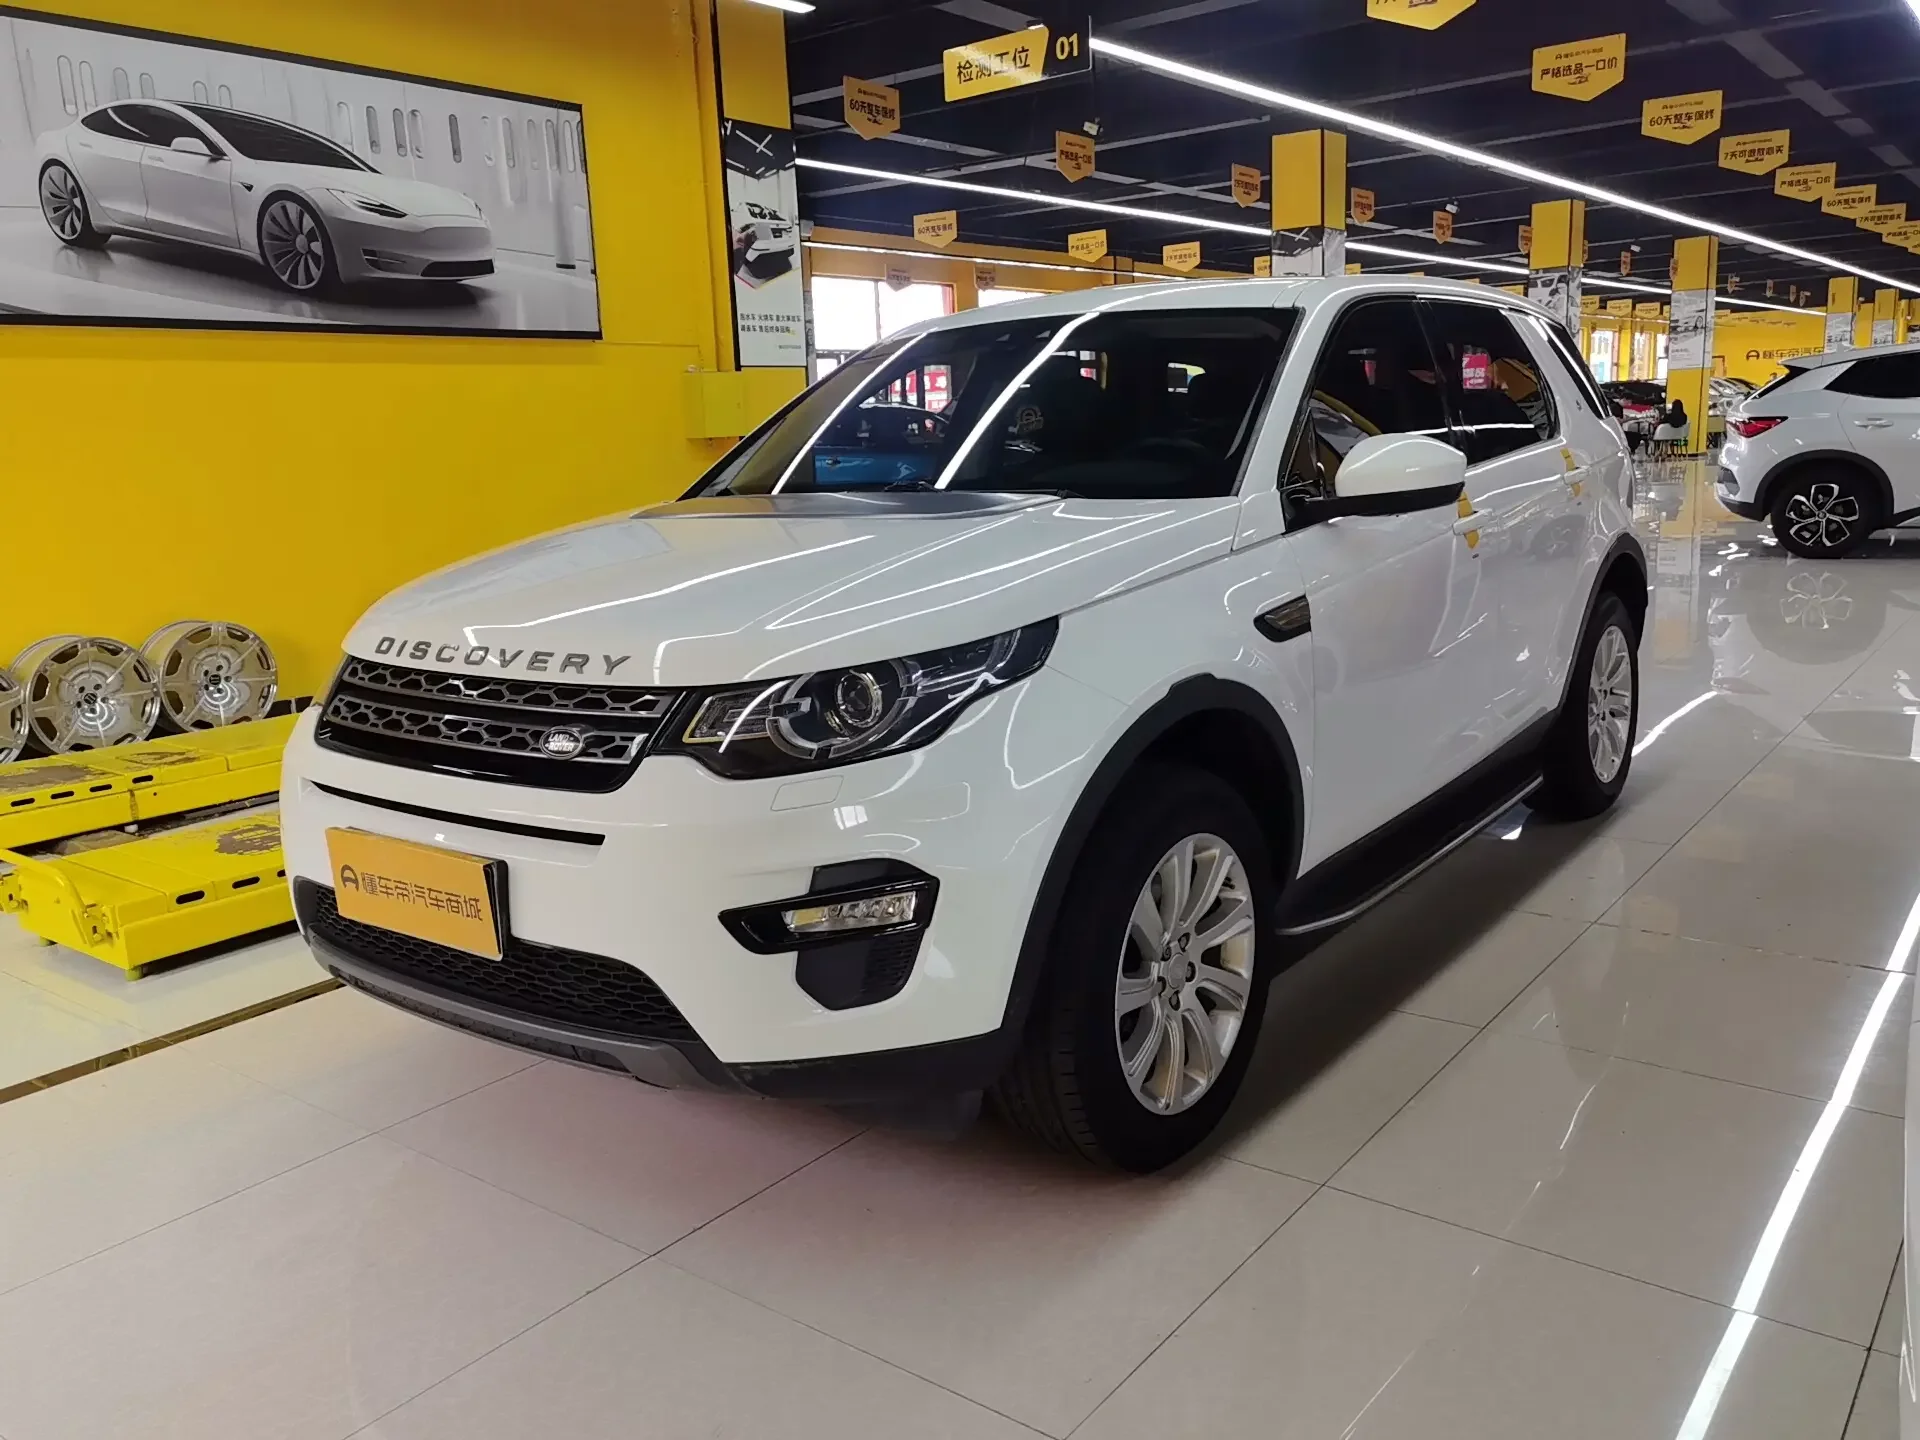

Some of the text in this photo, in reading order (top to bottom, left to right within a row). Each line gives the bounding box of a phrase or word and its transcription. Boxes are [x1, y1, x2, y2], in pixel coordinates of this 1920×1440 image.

[957, 33, 1079, 84] 检测工位 01
[1540, 56, 1618, 80] 严格选品一口价
[849, 98, 896, 121] 60天整车保修
[1649, 109, 1715, 127] 60天整车保修
[1723, 145, 1784, 161] 7天可退放心买
[374, 636, 631, 676] DISCOVERY
[547, 733, 570, 742] LAND
[547, 742, 575, 752] ROVER
[360, 871, 483, 921] 懂车帝汽车商城
